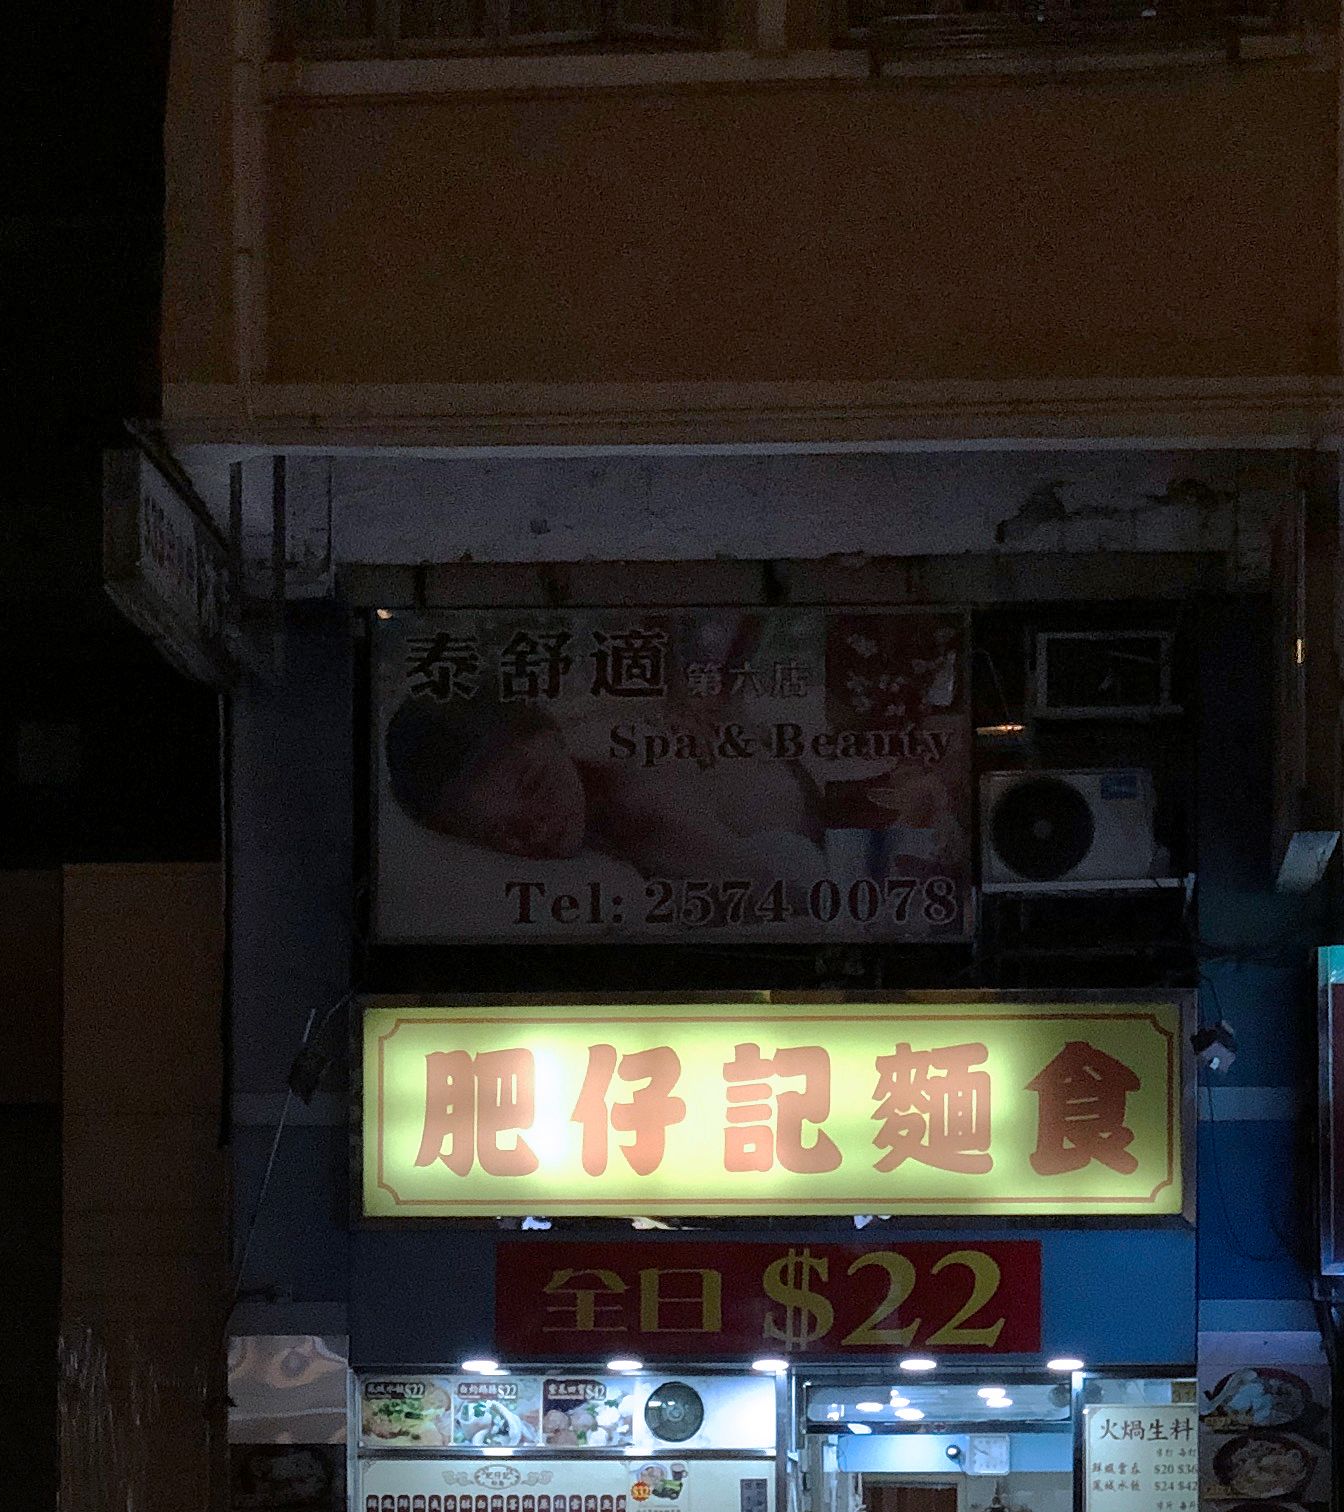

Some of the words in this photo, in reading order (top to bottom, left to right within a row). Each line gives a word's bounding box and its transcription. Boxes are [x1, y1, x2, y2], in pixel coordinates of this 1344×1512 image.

[406, 627, 672, 704] 泰舒適
[609, 723, 697, 769] Spa
[719, 726, 756, 762] &
[773, 723, 953, 766] Beauty
[505, 880, 624, 925] Tel:
[645, 880, 794, 926] 2574
[810, 877, 960, 925] 0078
[413, 1040, 1141, 1178] 肥仔記麵食
[541, 1266, 721, 1335] 全日
[761, 1247, 1007, 1349] $22
[1154, 1463, 1175, 1475] $20
[1154, 1480, 1175, 1492] $24
[1178, 1480, 1198, 1492] $42
